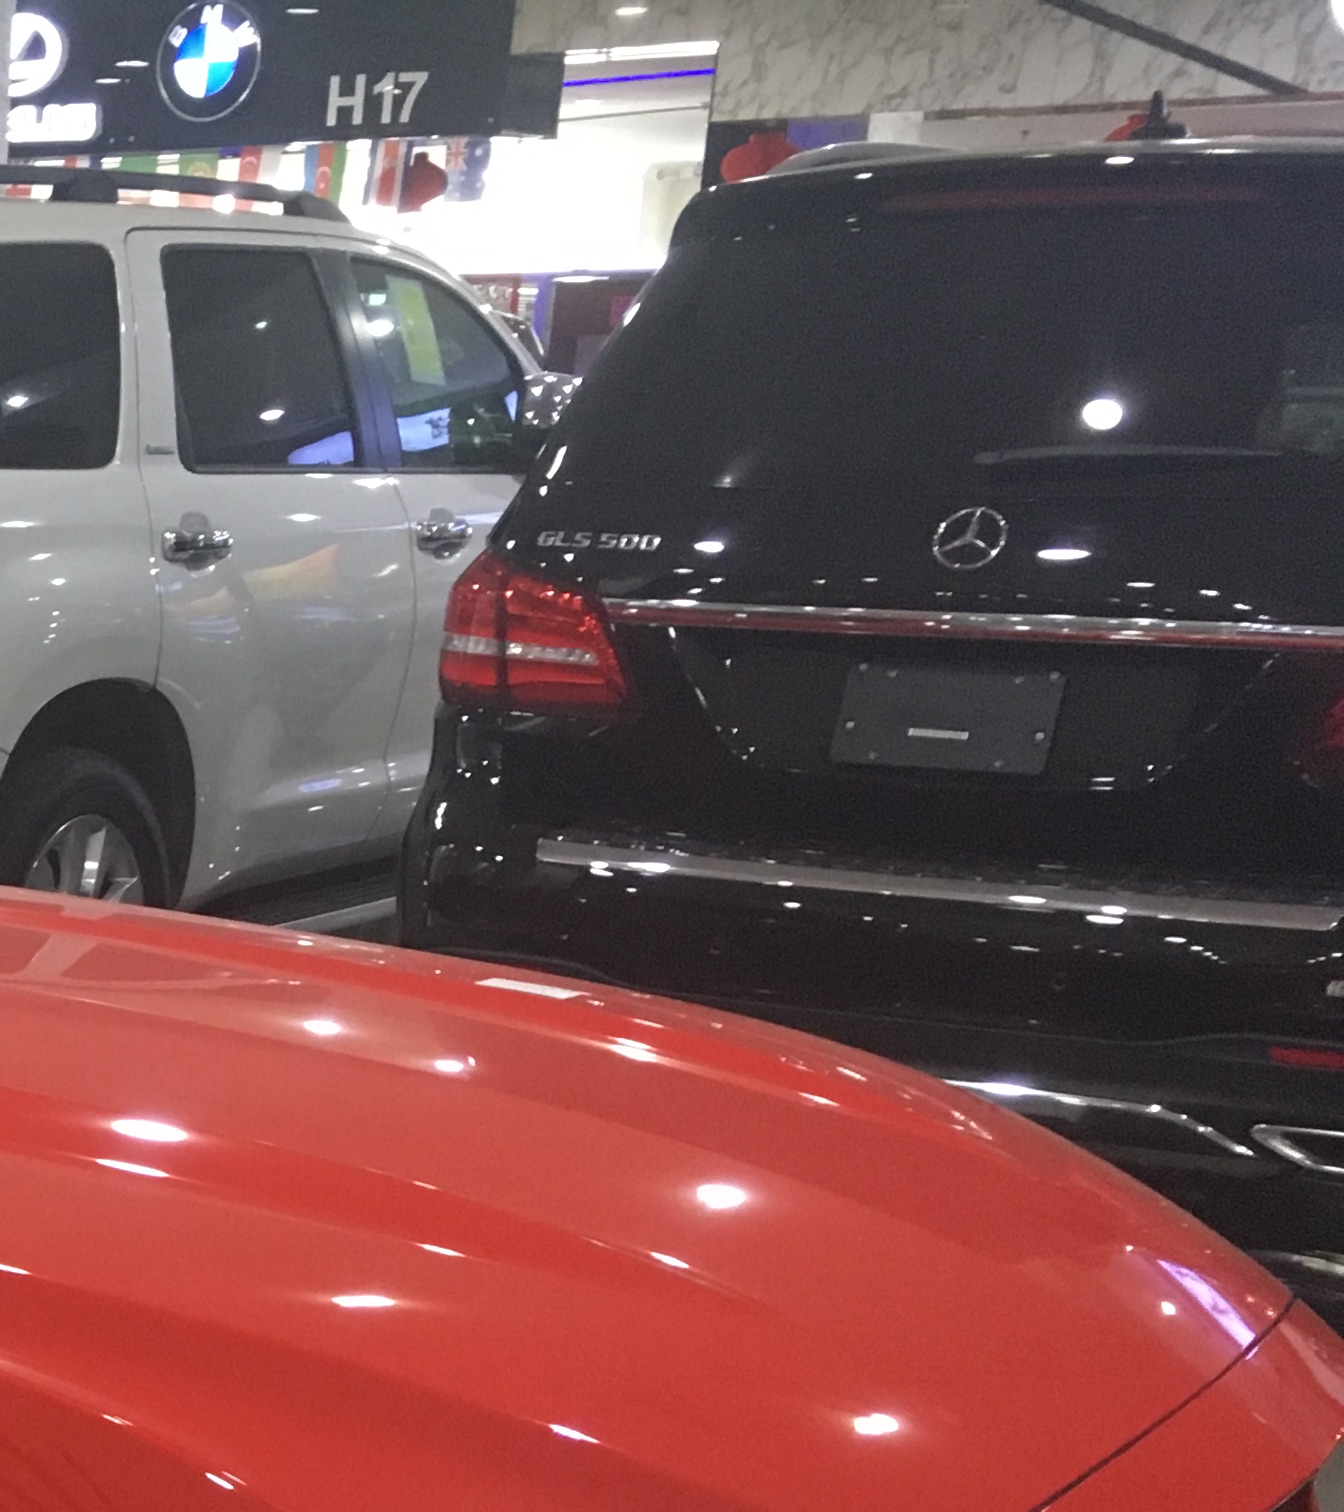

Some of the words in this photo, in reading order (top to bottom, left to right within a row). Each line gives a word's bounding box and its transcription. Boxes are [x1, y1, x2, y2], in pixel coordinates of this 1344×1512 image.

[168, 3, 259, 48] BMW
[537, 531, 592, 548] GLS
[597, 533, 662, 551] 500
